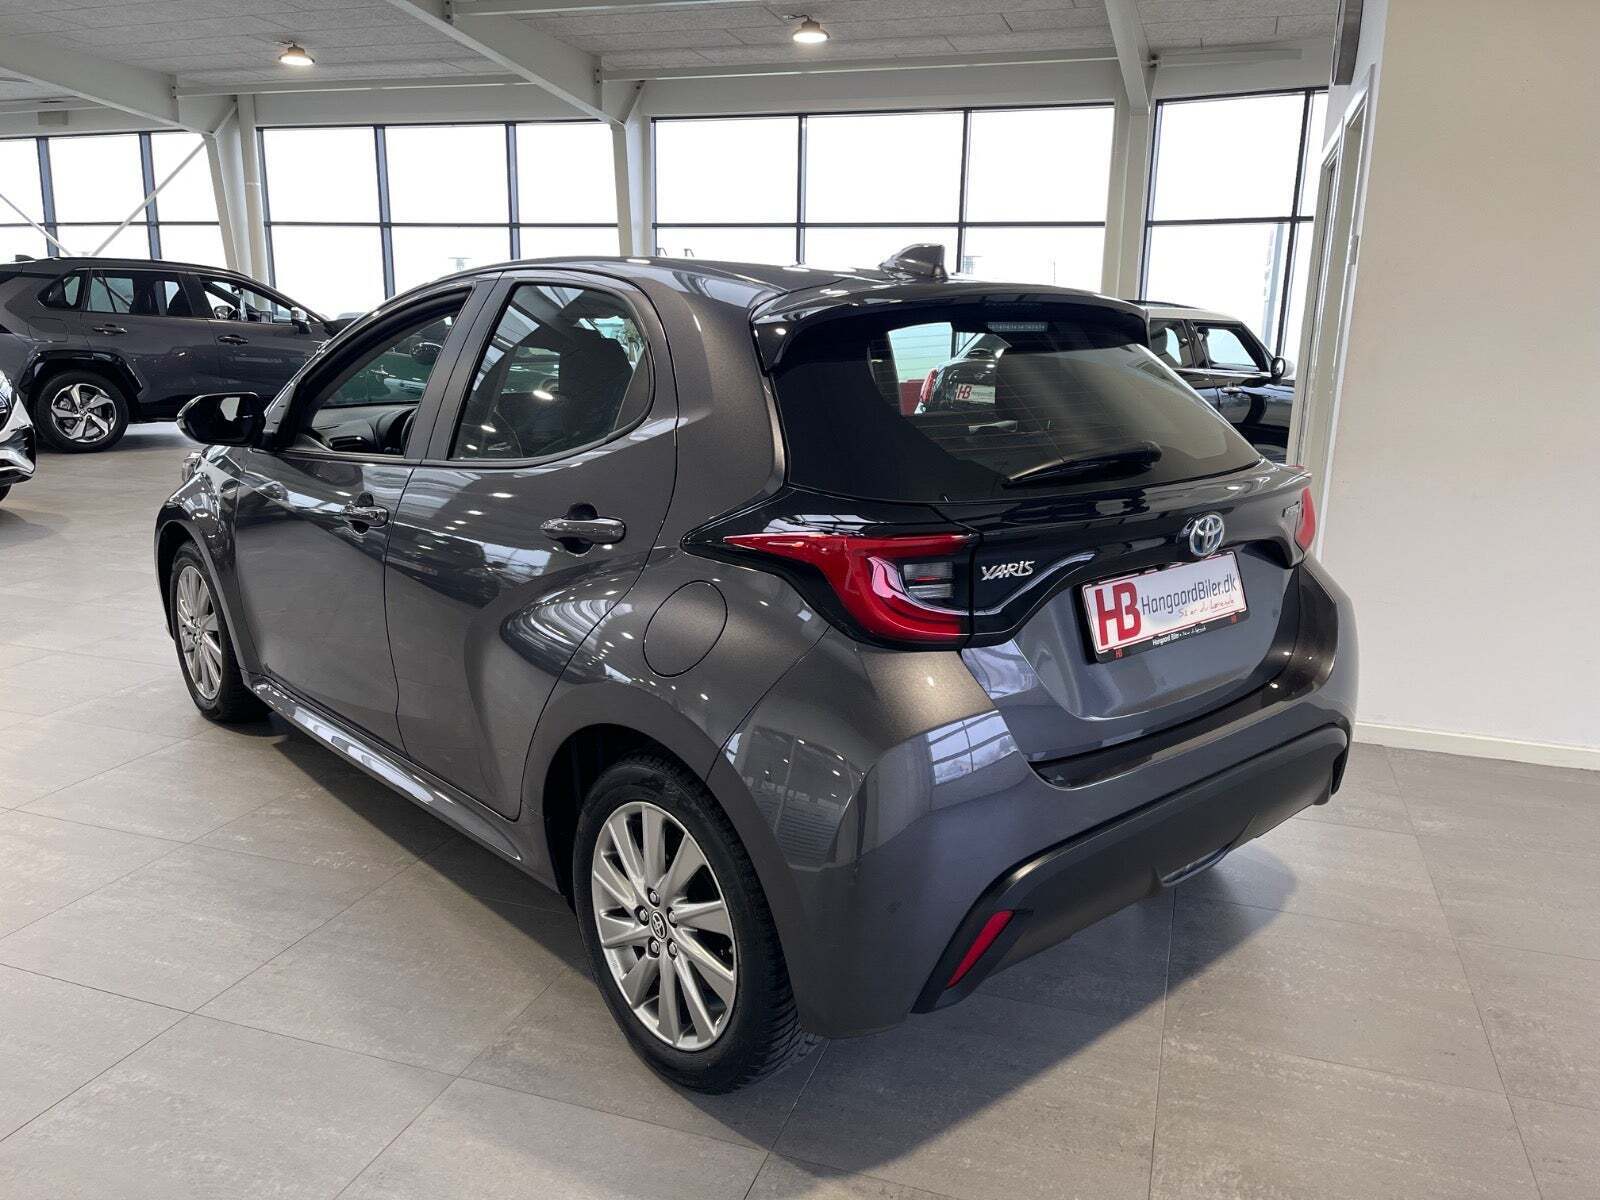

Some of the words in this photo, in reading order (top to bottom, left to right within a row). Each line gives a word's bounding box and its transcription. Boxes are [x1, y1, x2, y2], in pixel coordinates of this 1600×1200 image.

[980, 560, 1035, 581] YARIS
[1095, 582, 1142, 646] HB
[1141, 573, 1237, 616] HangaardBiler.dk
